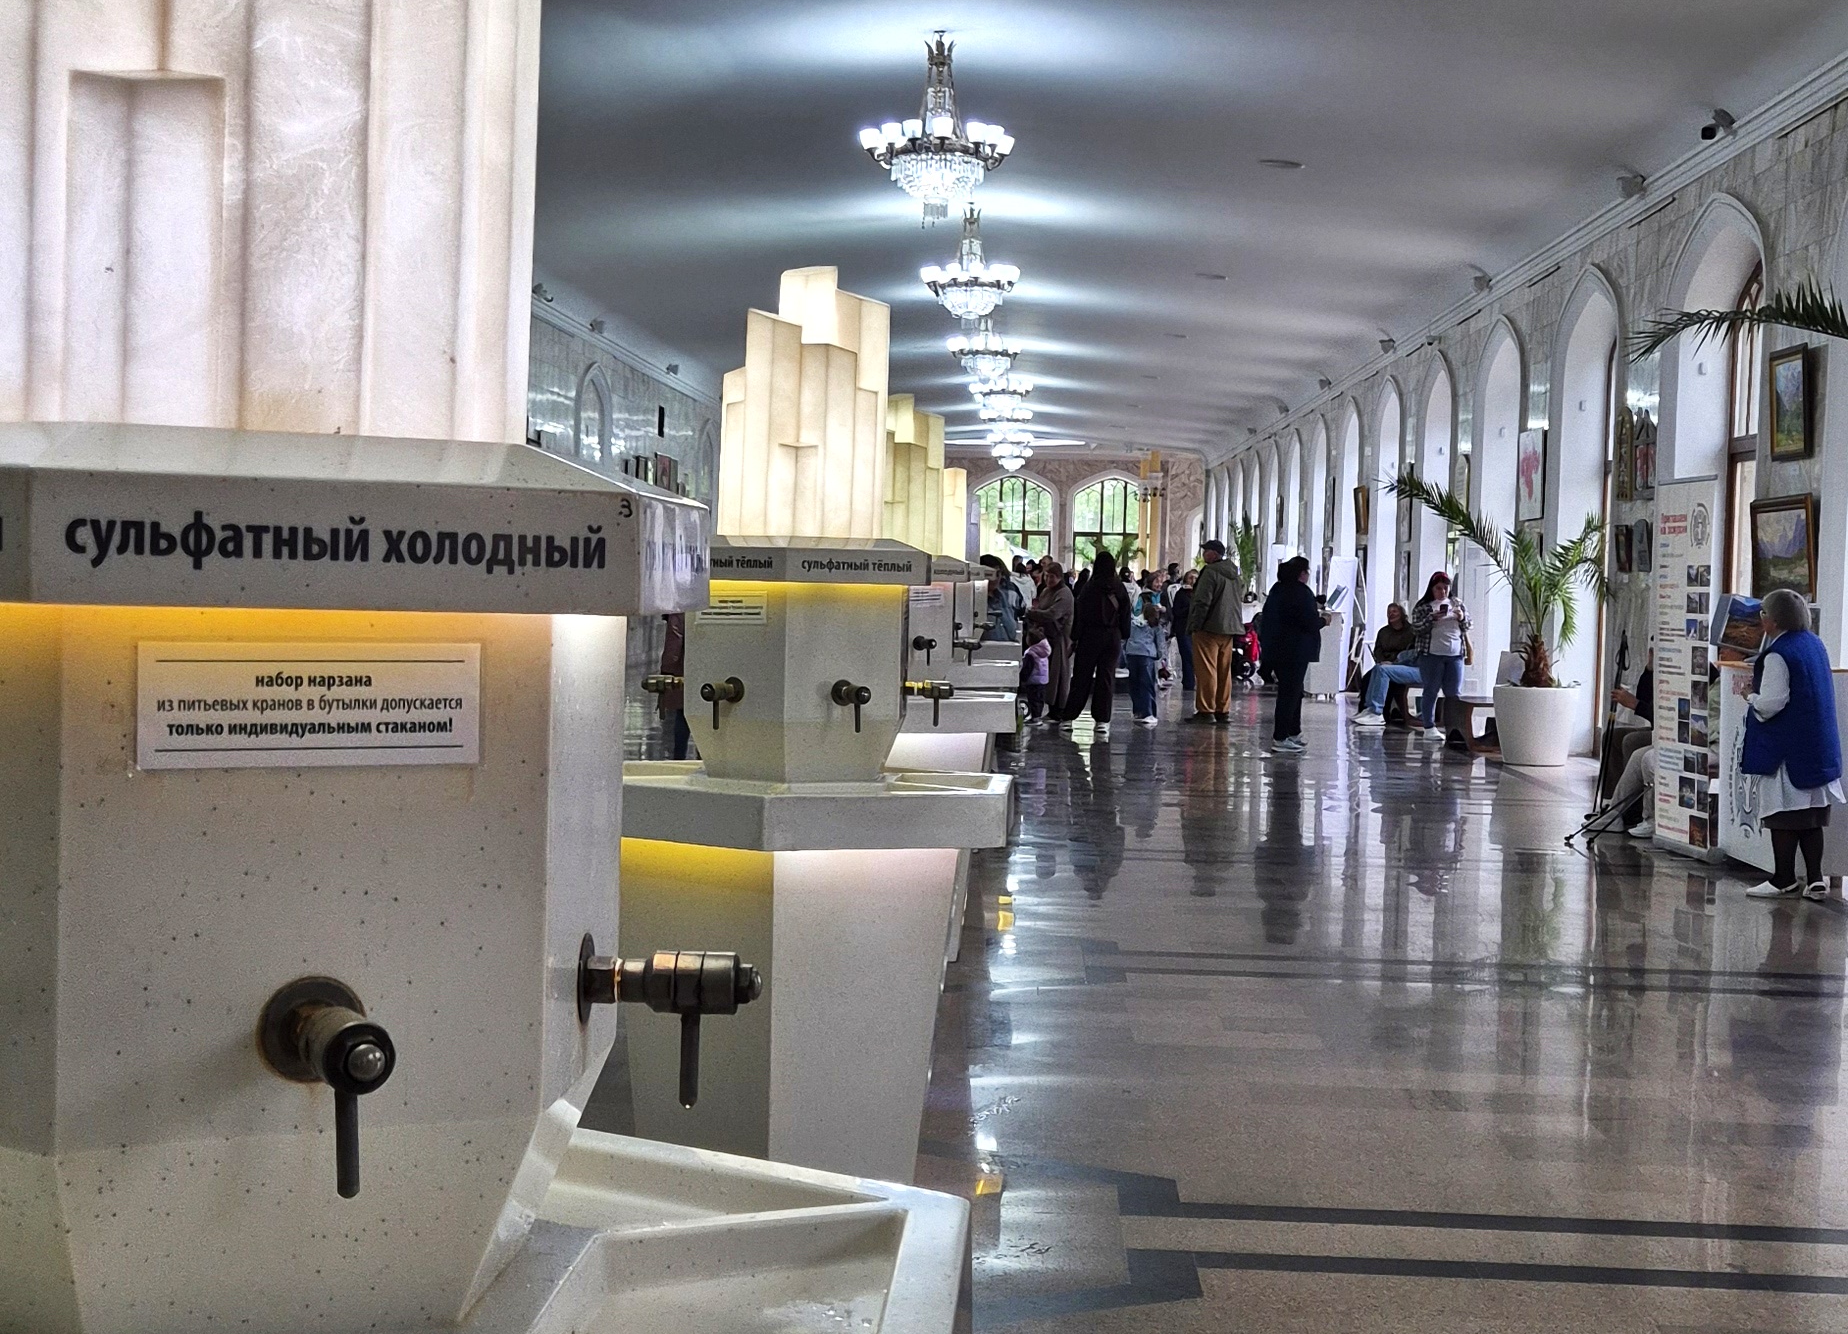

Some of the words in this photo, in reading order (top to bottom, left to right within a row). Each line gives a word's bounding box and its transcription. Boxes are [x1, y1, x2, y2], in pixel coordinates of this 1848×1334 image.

[64, 510, 370, 570] сульфатный
[381, 524, 606, 575] холодный
[801, 558, 869, 573] сульфатный
[872, 559, 912, 573] тёплый
[255, 671, 304, 691] набор
[307, 675, 373, 691] нарзана
[157, 699, 174, 712] из
[178, 698, 249, 712] питьевых
[252, 698, 303, 715] кранов
[306, 698, 315, 711] в
[319, 694, 377, 715] бутылки
[380, 697, 463, 714] допускается
[167, 723, 224, 737] только
[227, 721, 372, 739] индивидуальным
[376, 717, 453, 735] стаканом!
